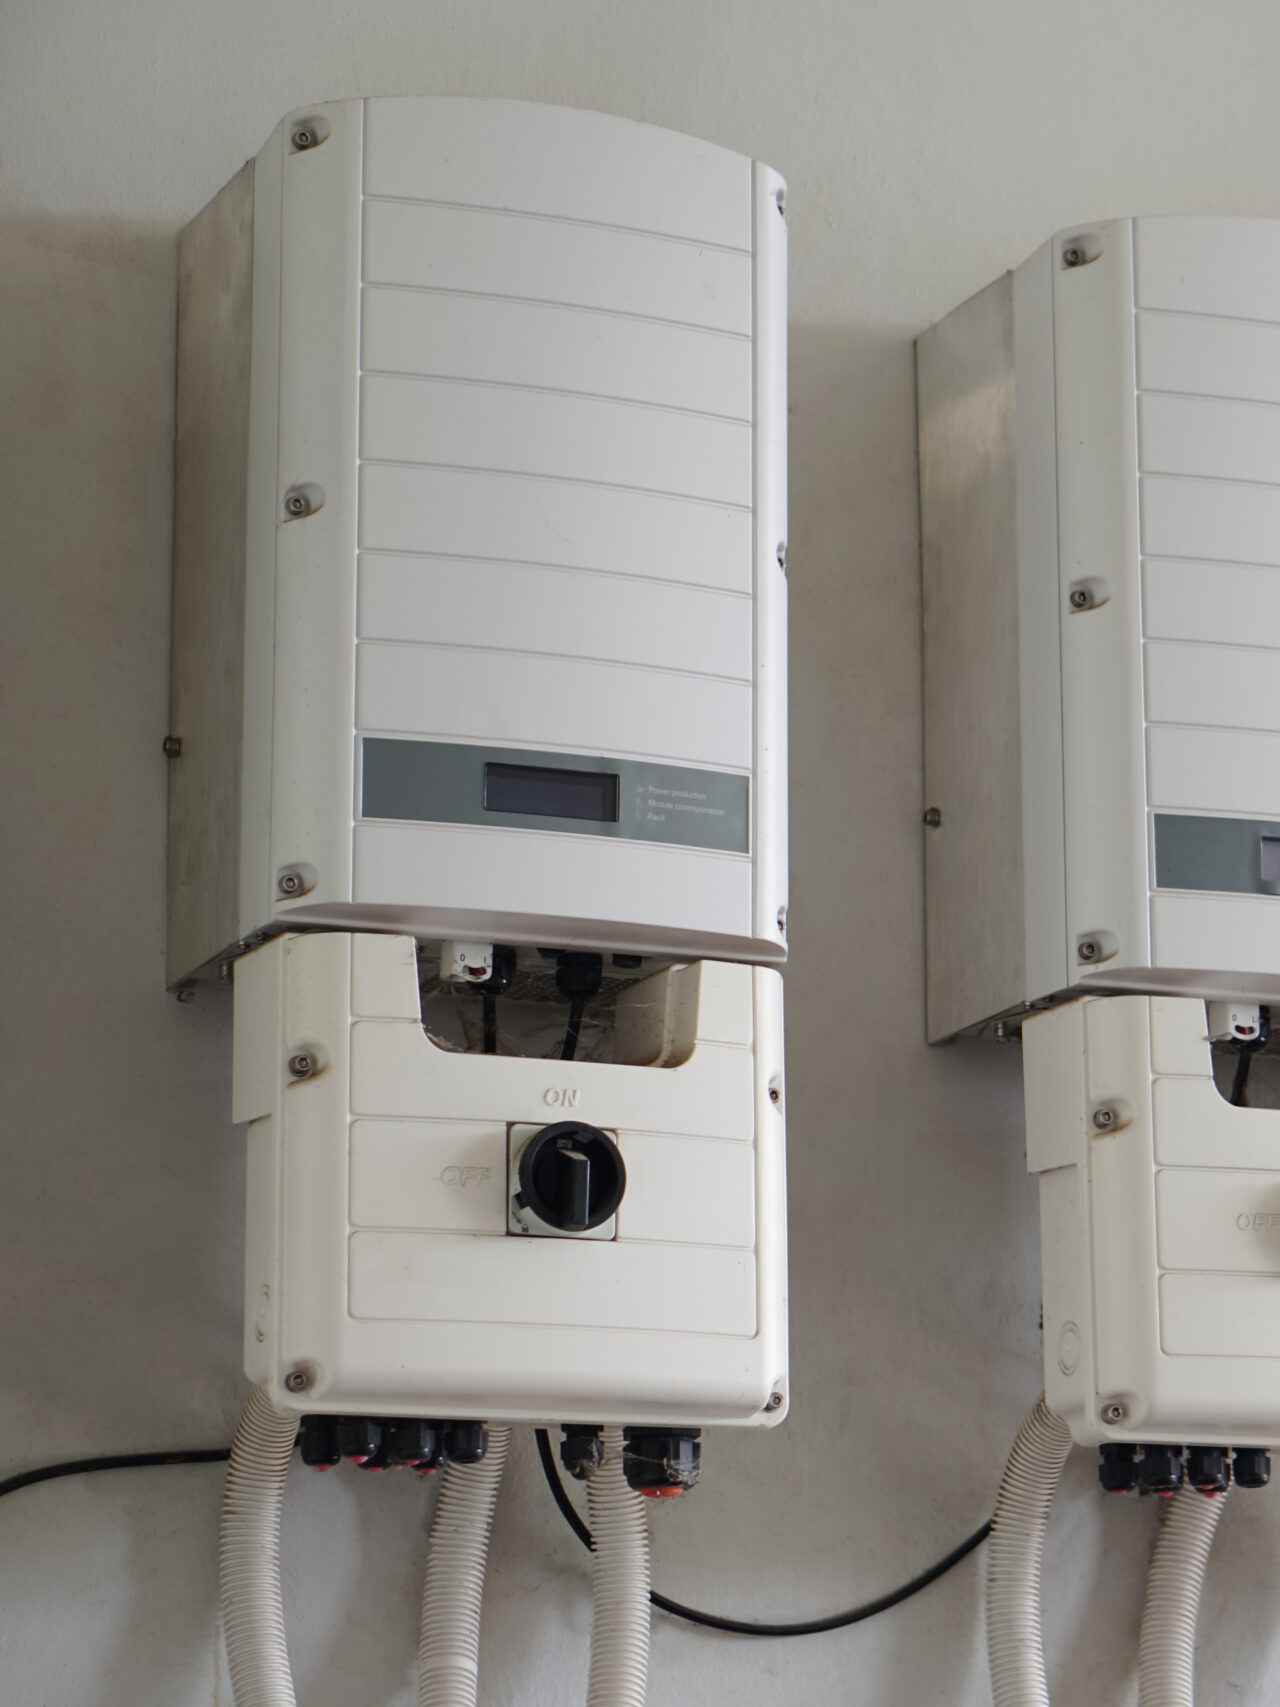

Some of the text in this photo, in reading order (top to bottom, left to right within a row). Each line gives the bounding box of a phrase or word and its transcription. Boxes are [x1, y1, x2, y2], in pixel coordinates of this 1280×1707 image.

[648, 785, 670, 796] Power
[543, 1087, 579, 1107] ON
[440, 1165, 491, 1187] OFF
[1236, 1212, 1280, 1232] OFF
